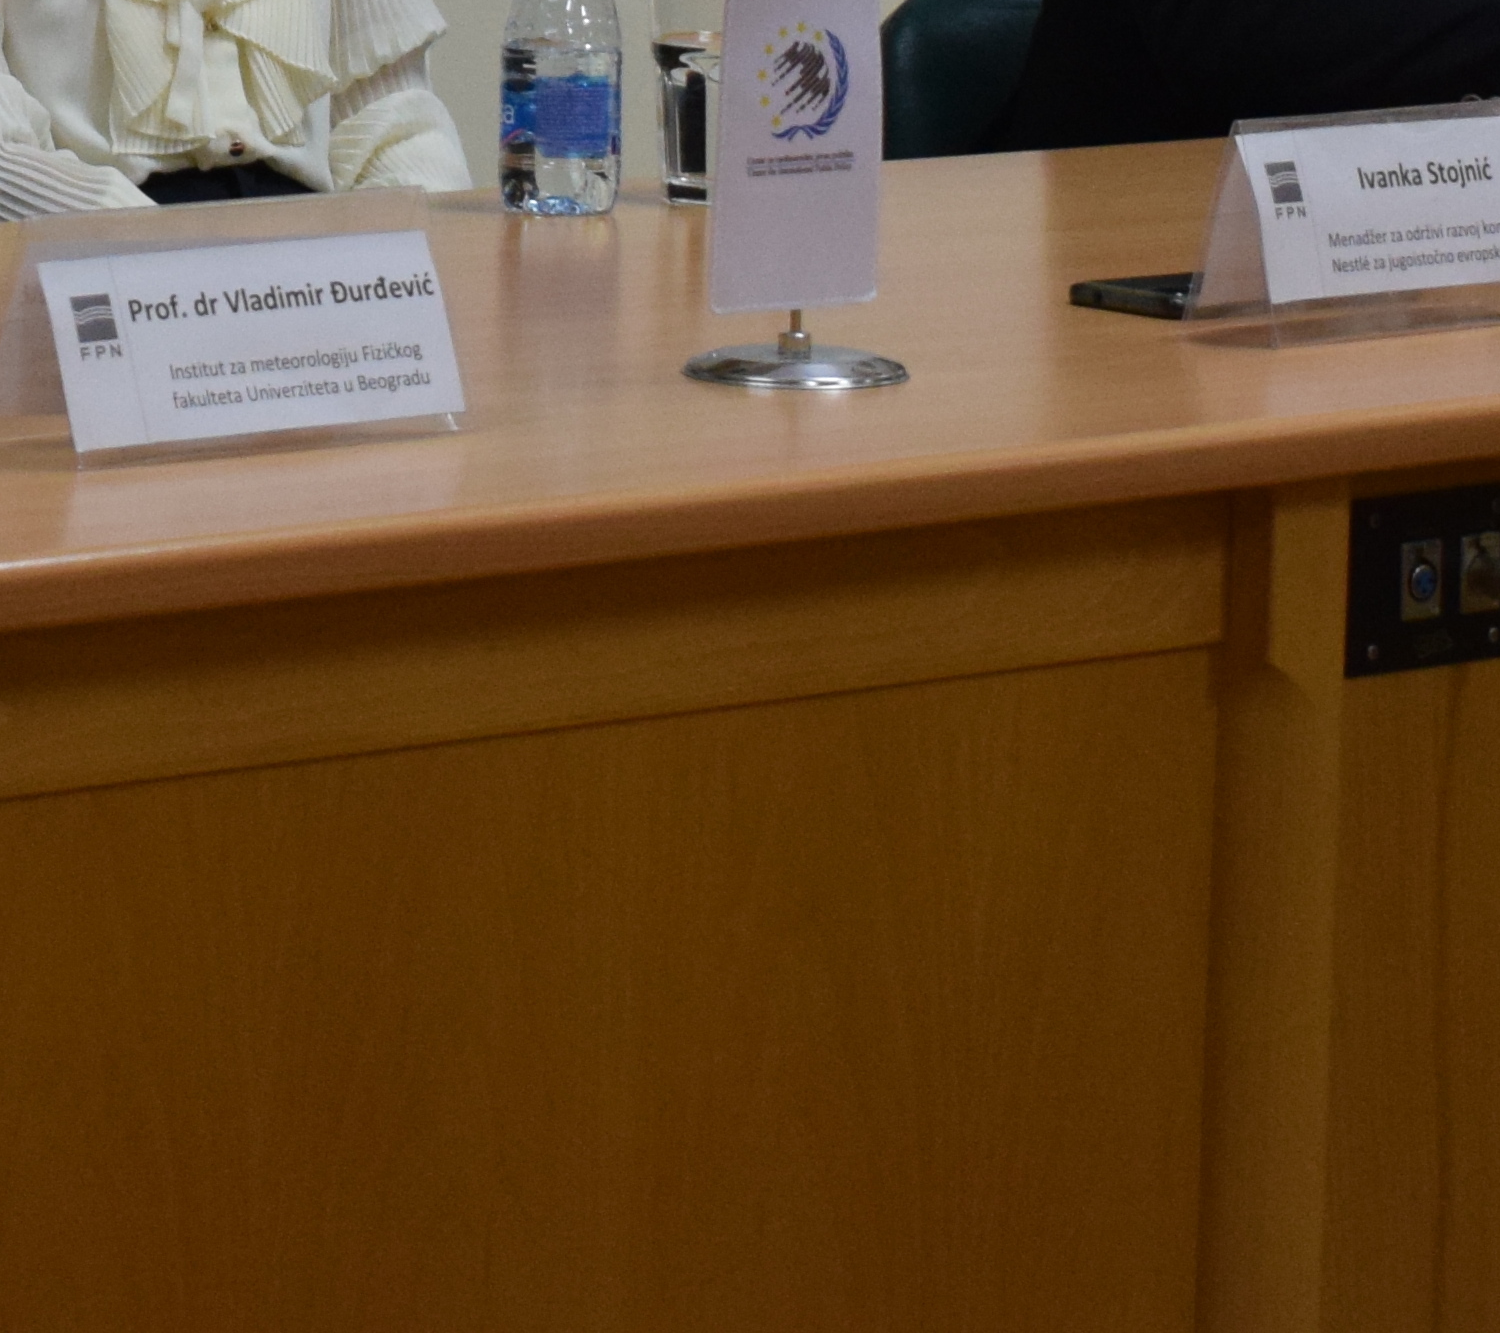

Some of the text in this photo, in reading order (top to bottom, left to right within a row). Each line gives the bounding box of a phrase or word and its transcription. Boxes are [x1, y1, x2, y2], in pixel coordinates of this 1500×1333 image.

[1358, 157, 1492, 189] Ivanka Stojnić
[1275, 206, 1306, 219] FPN
[1328, 229, 1386, 247] Menadžer
[1390, 231, 1403, 243] za
[1406, 225, 1444, 241] održivi
[1446, 223, 1480, 239] razvoj
[1332, 255, 1370, 273] Nestlé
[1374, 257, 1386, 270] za
[1388, 249, 1454, 272] jugoistočno
[128, 273, 434, 322] Prof. dr Vladimir Đurđević
[80, 345, 122, 361] FPN
[170, 343, 422, 380] Institut za meteorologiju Fizičkog
[173, 369, 430, 409] fakulteta Univerziteta u Beogradu
